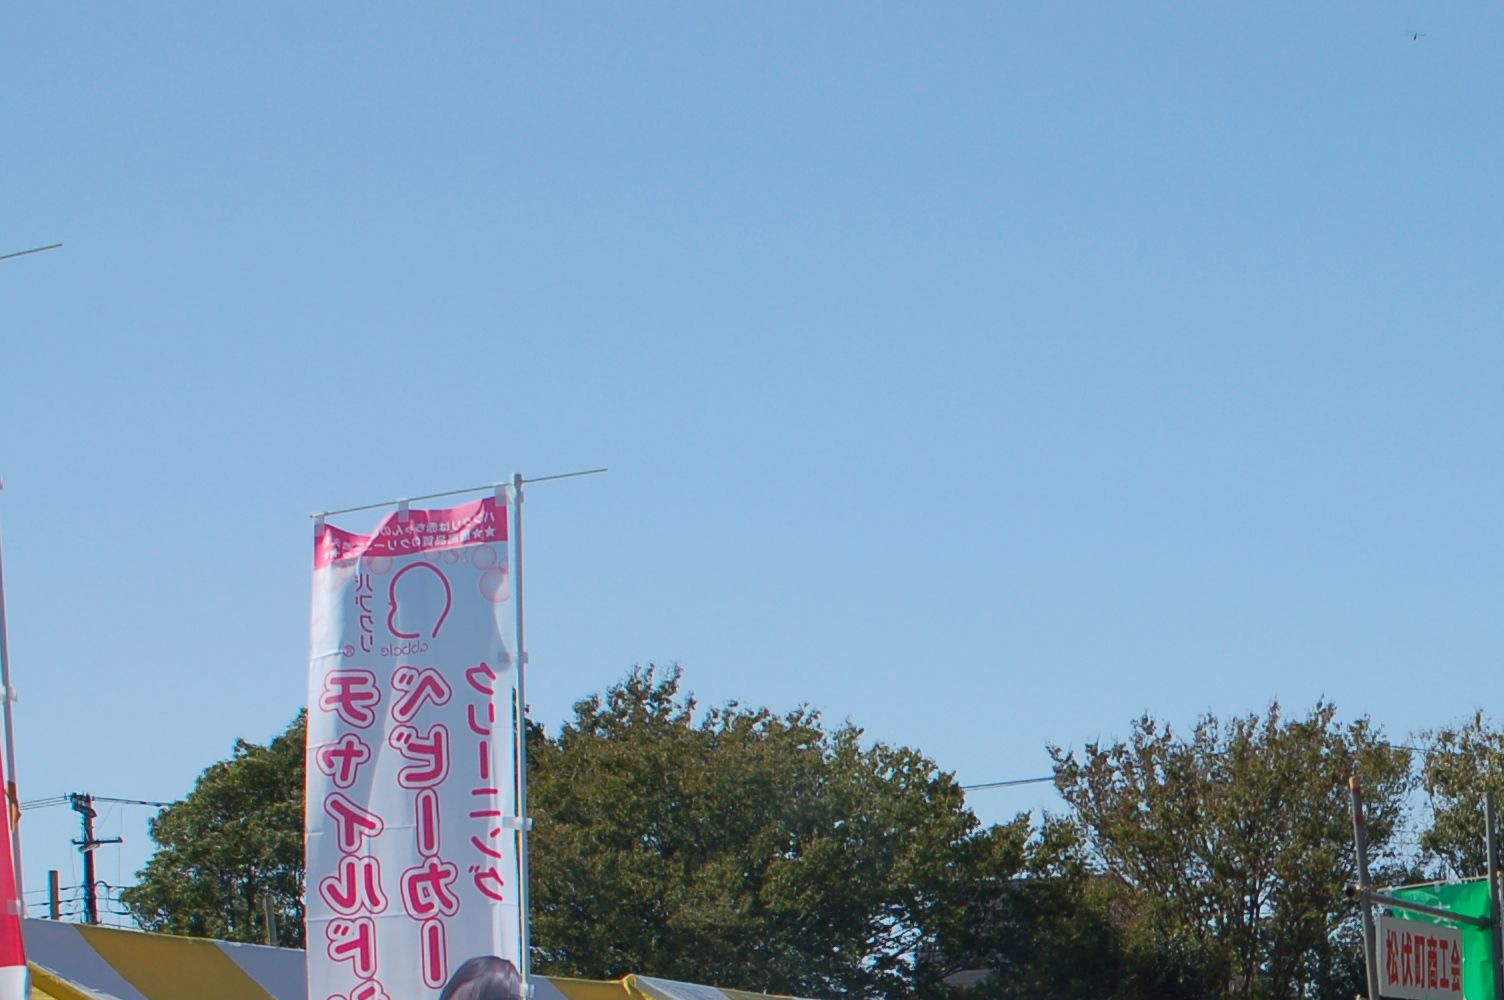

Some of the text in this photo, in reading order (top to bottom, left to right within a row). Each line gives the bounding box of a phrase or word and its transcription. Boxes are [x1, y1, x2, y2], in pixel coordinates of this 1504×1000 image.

[1386, 928, 1461, 992] 松伏町商工会
